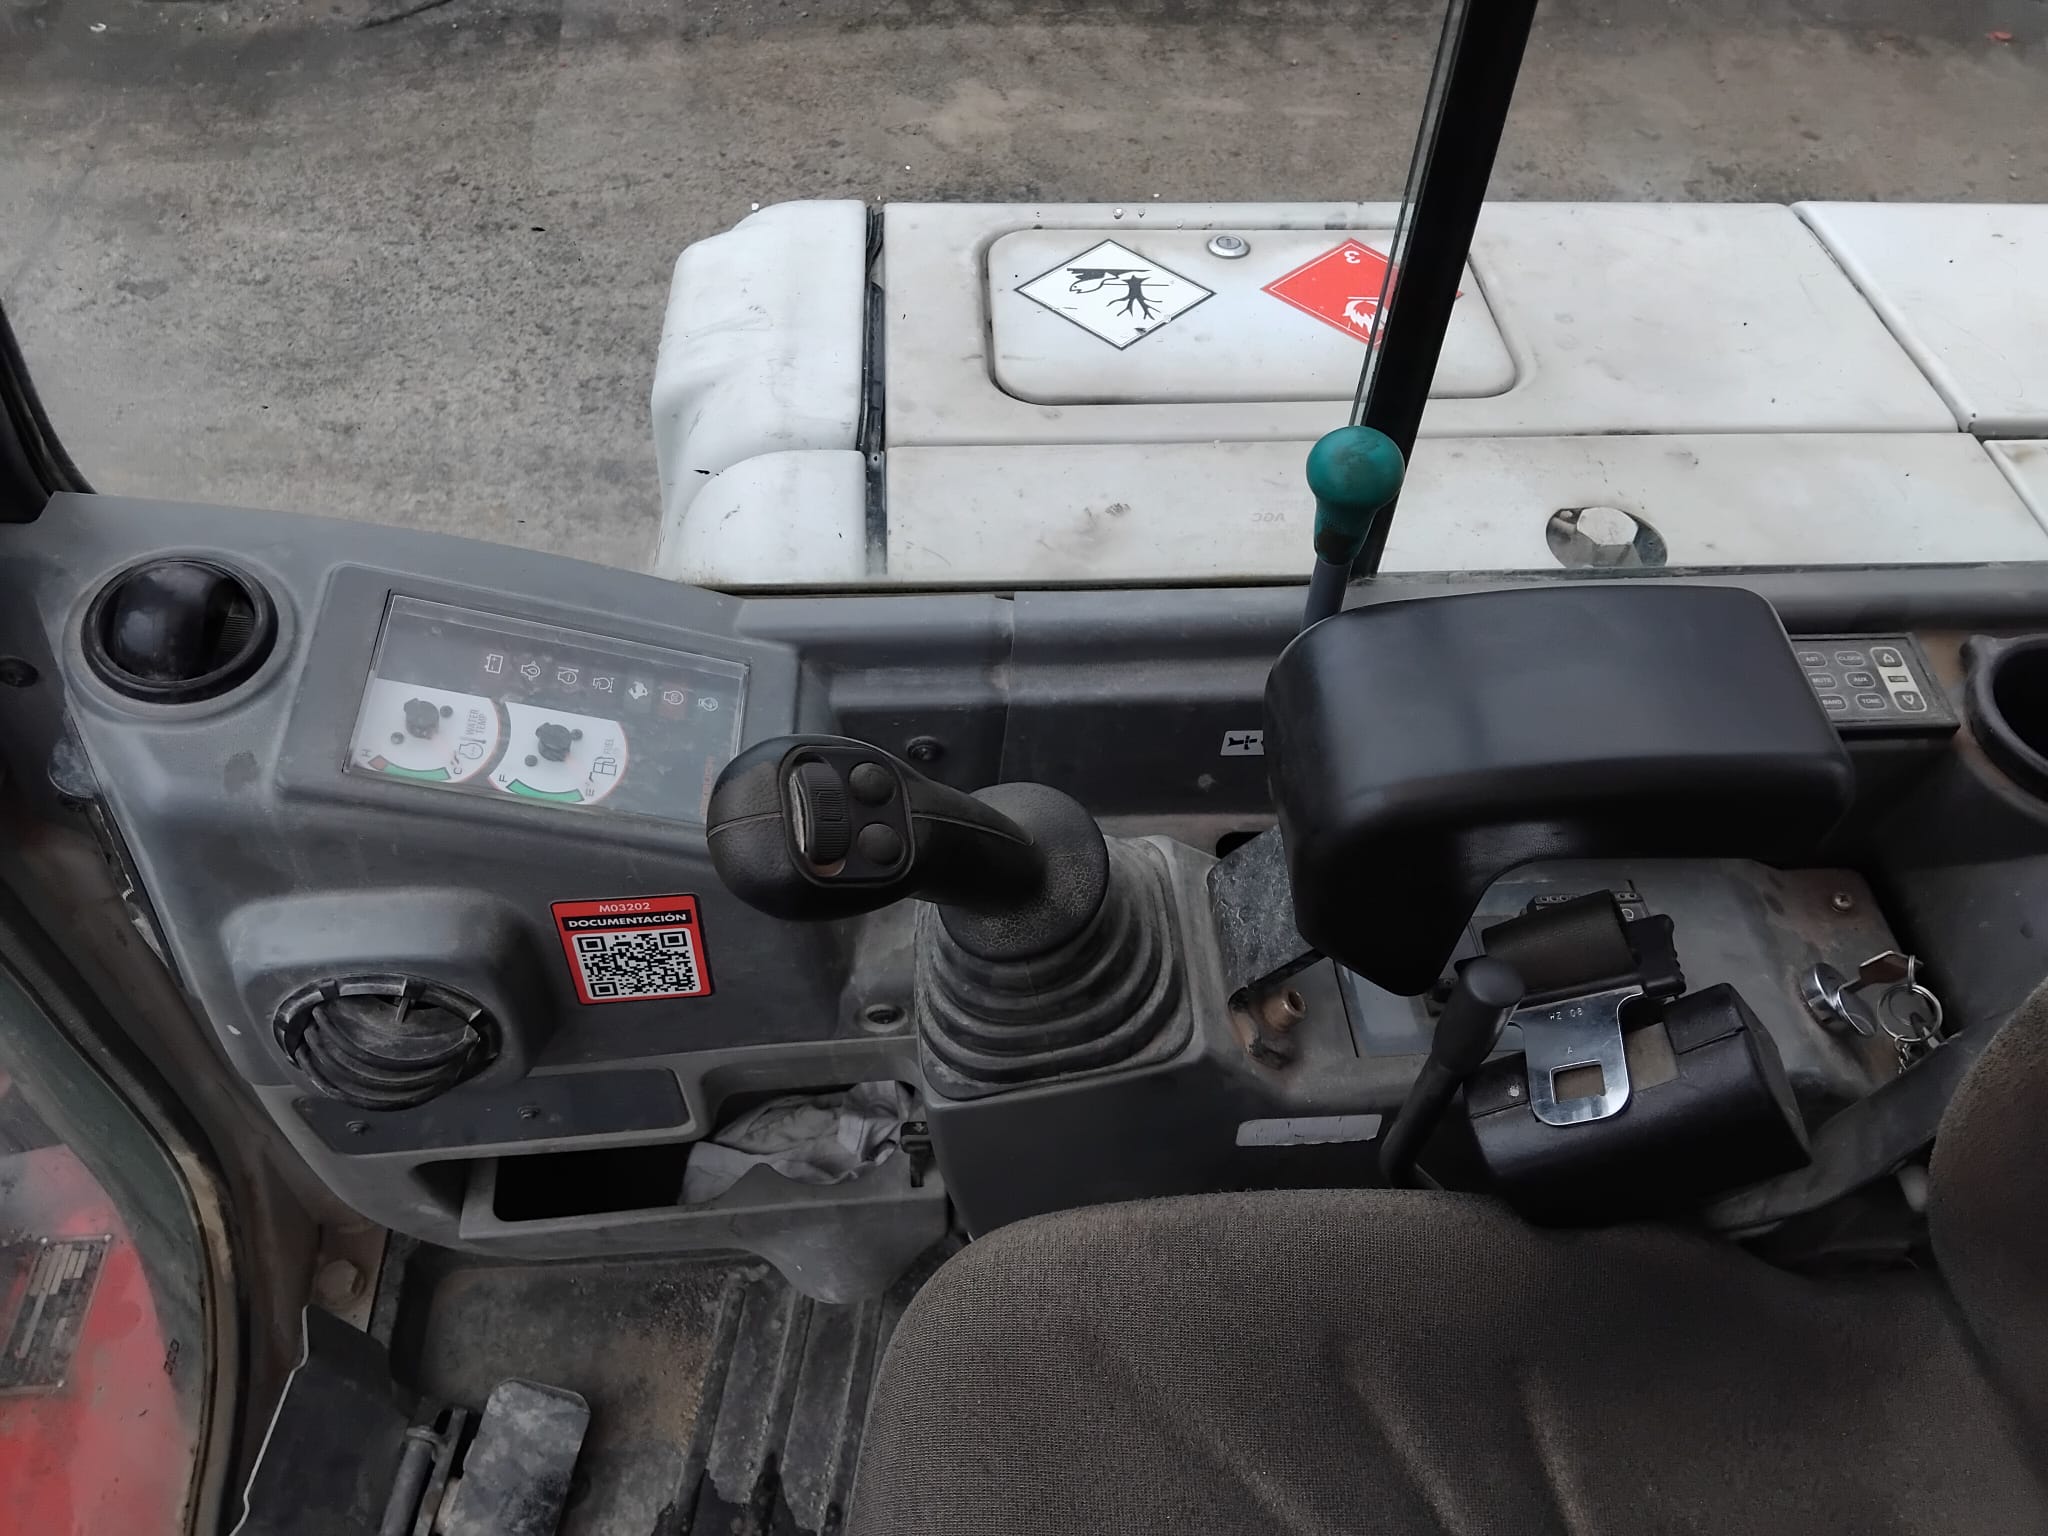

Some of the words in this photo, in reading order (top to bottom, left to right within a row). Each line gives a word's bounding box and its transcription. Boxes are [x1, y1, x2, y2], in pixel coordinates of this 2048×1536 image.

[1344, 250, 1361, 264] 3
[599, 902, 651, 913] M03202
[568, 913, 687, 928] DOCUMENTACIÓN
